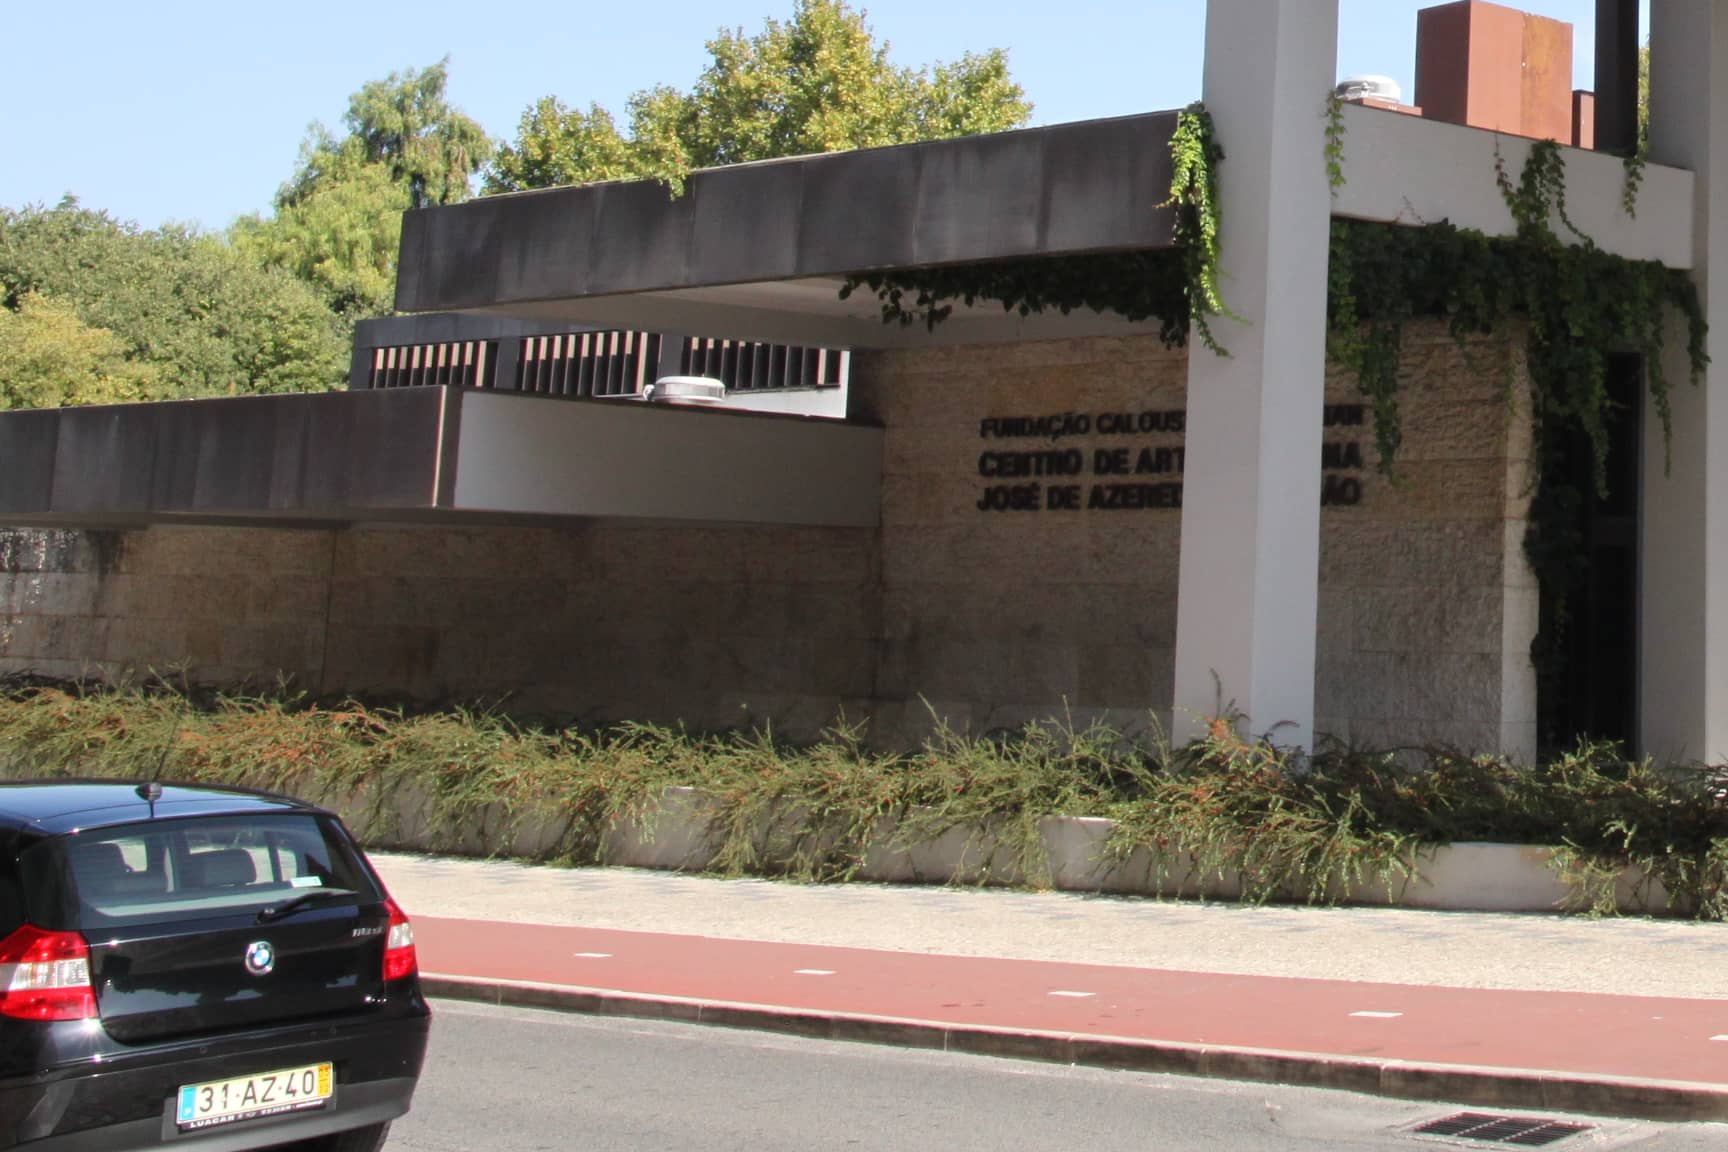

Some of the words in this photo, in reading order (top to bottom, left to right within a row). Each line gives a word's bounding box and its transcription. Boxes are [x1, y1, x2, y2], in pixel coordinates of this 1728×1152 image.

[980, 412, 1091, 442] FUNDAÇÃO
[1096, 410, 1186, 434] CALOUS
[978, 450, 1084, 478] CENTRO
[1094, 448, 1131, 475] DE
[1135, 446, 1186, 475] ART
[976, 481, 1042, 511] JOSÉ
[1047, 485, 1081, 511] DE
